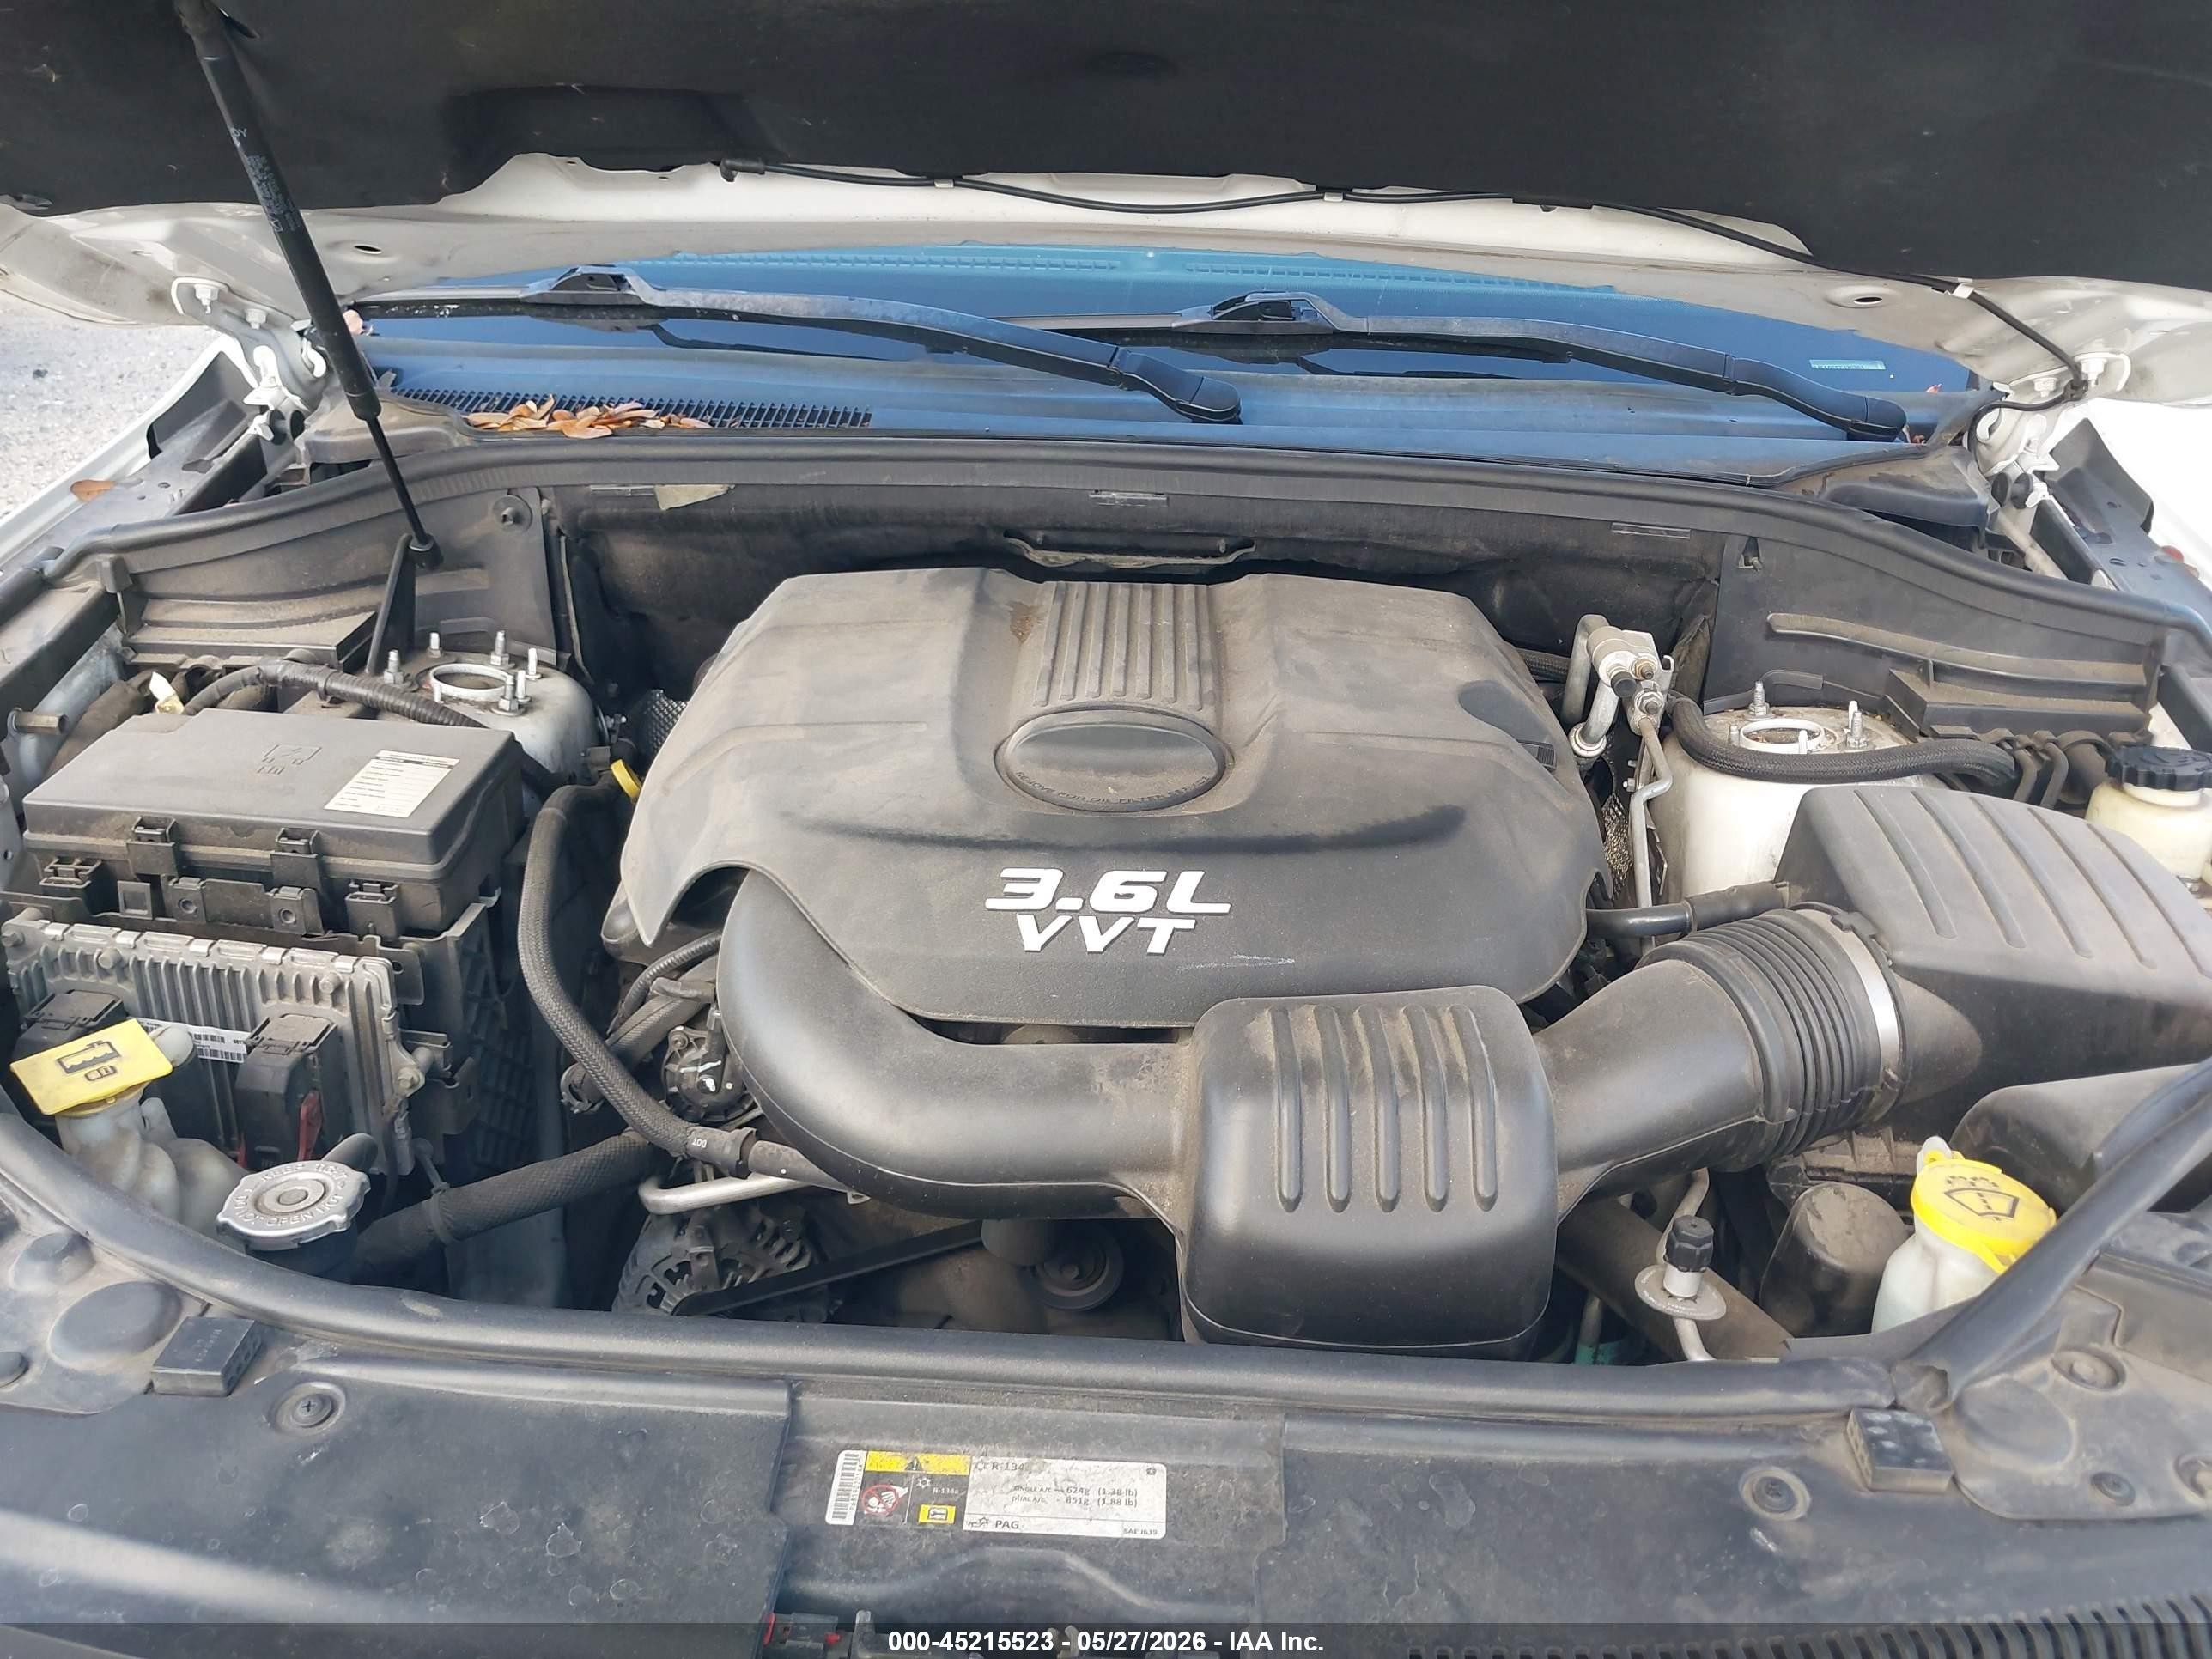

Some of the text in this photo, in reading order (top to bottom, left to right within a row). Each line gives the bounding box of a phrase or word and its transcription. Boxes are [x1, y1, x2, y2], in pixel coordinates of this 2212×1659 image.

[984, 867, 1232, 914] 3.6L
[1016, 913, 1197, 956] VVT
[994, 1520, 1020, 1529] PAG
